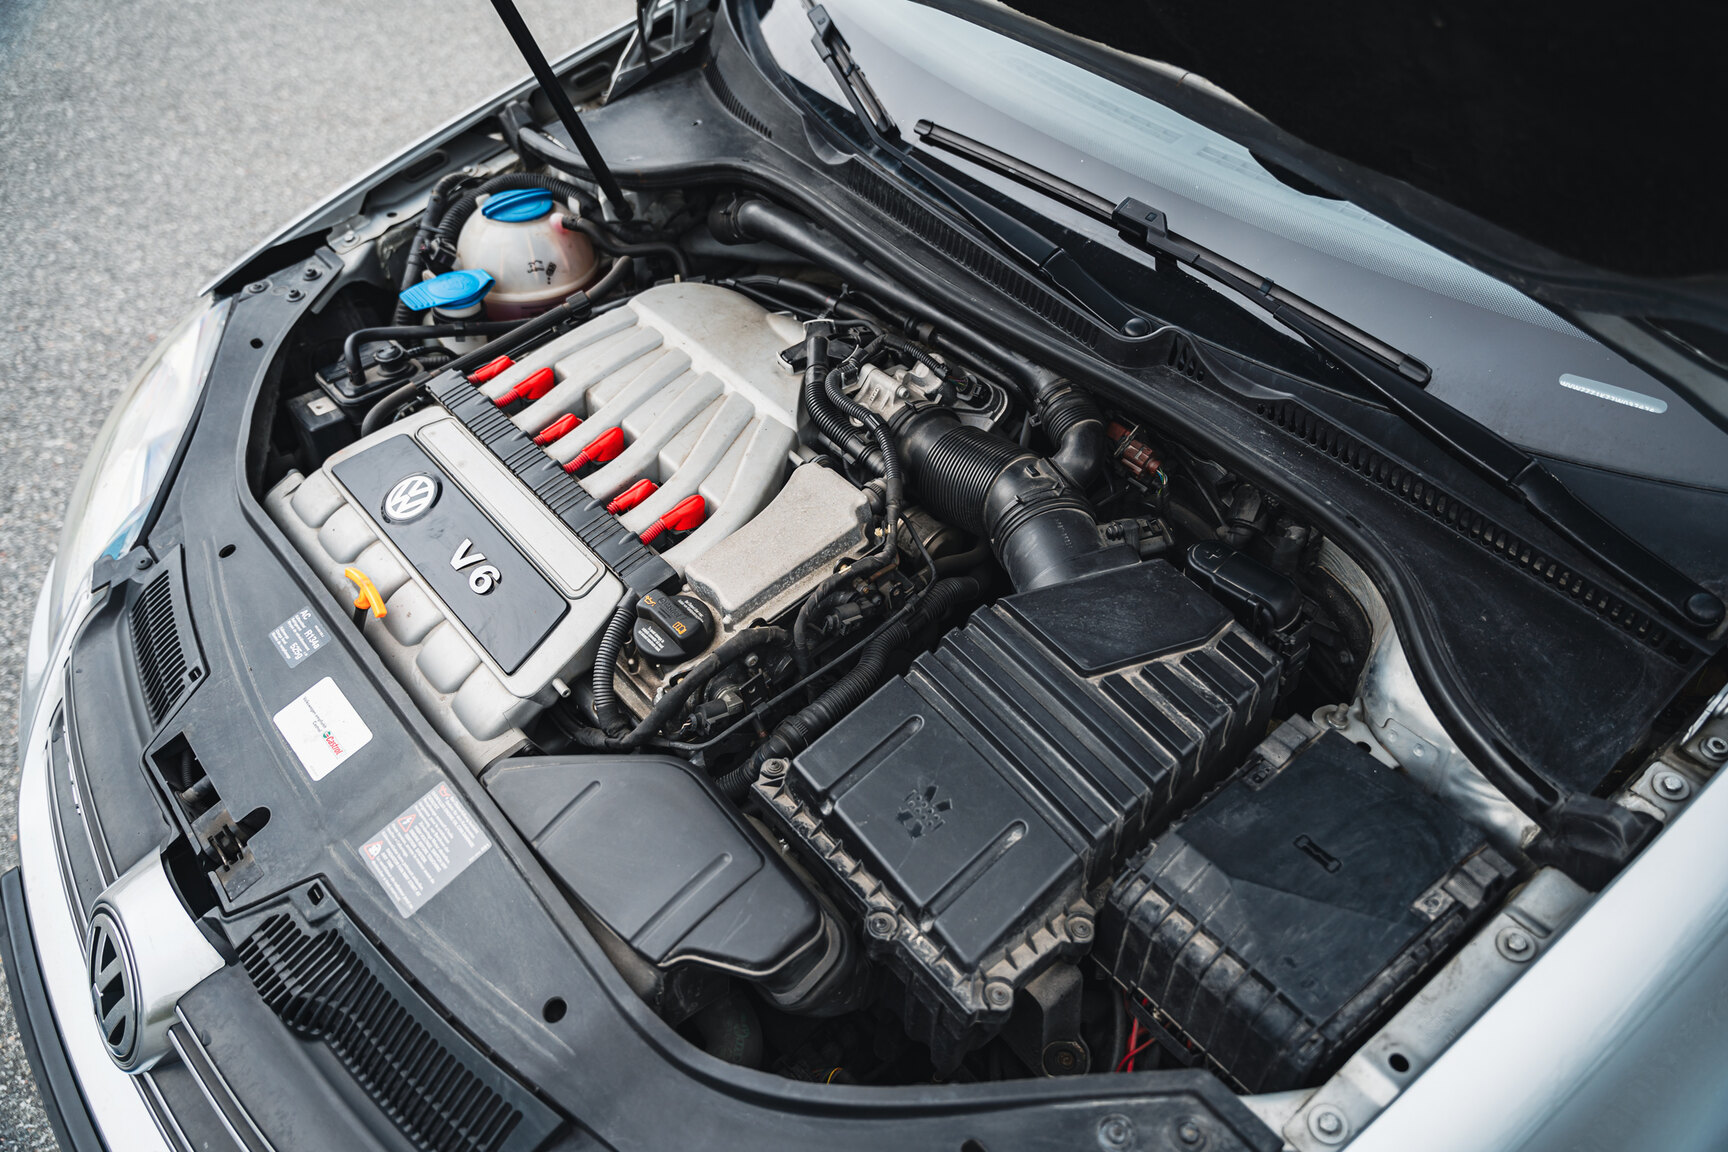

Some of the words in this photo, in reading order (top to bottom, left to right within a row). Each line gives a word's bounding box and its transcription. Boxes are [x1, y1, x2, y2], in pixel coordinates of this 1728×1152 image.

[450, 538, 502, 596] V6
[300, 609, 312, 621] AC
[304, 629, 320, 650] R134a
[290, 642, 304, 660] 525g
[325, 735, 344, 756] Castrol
